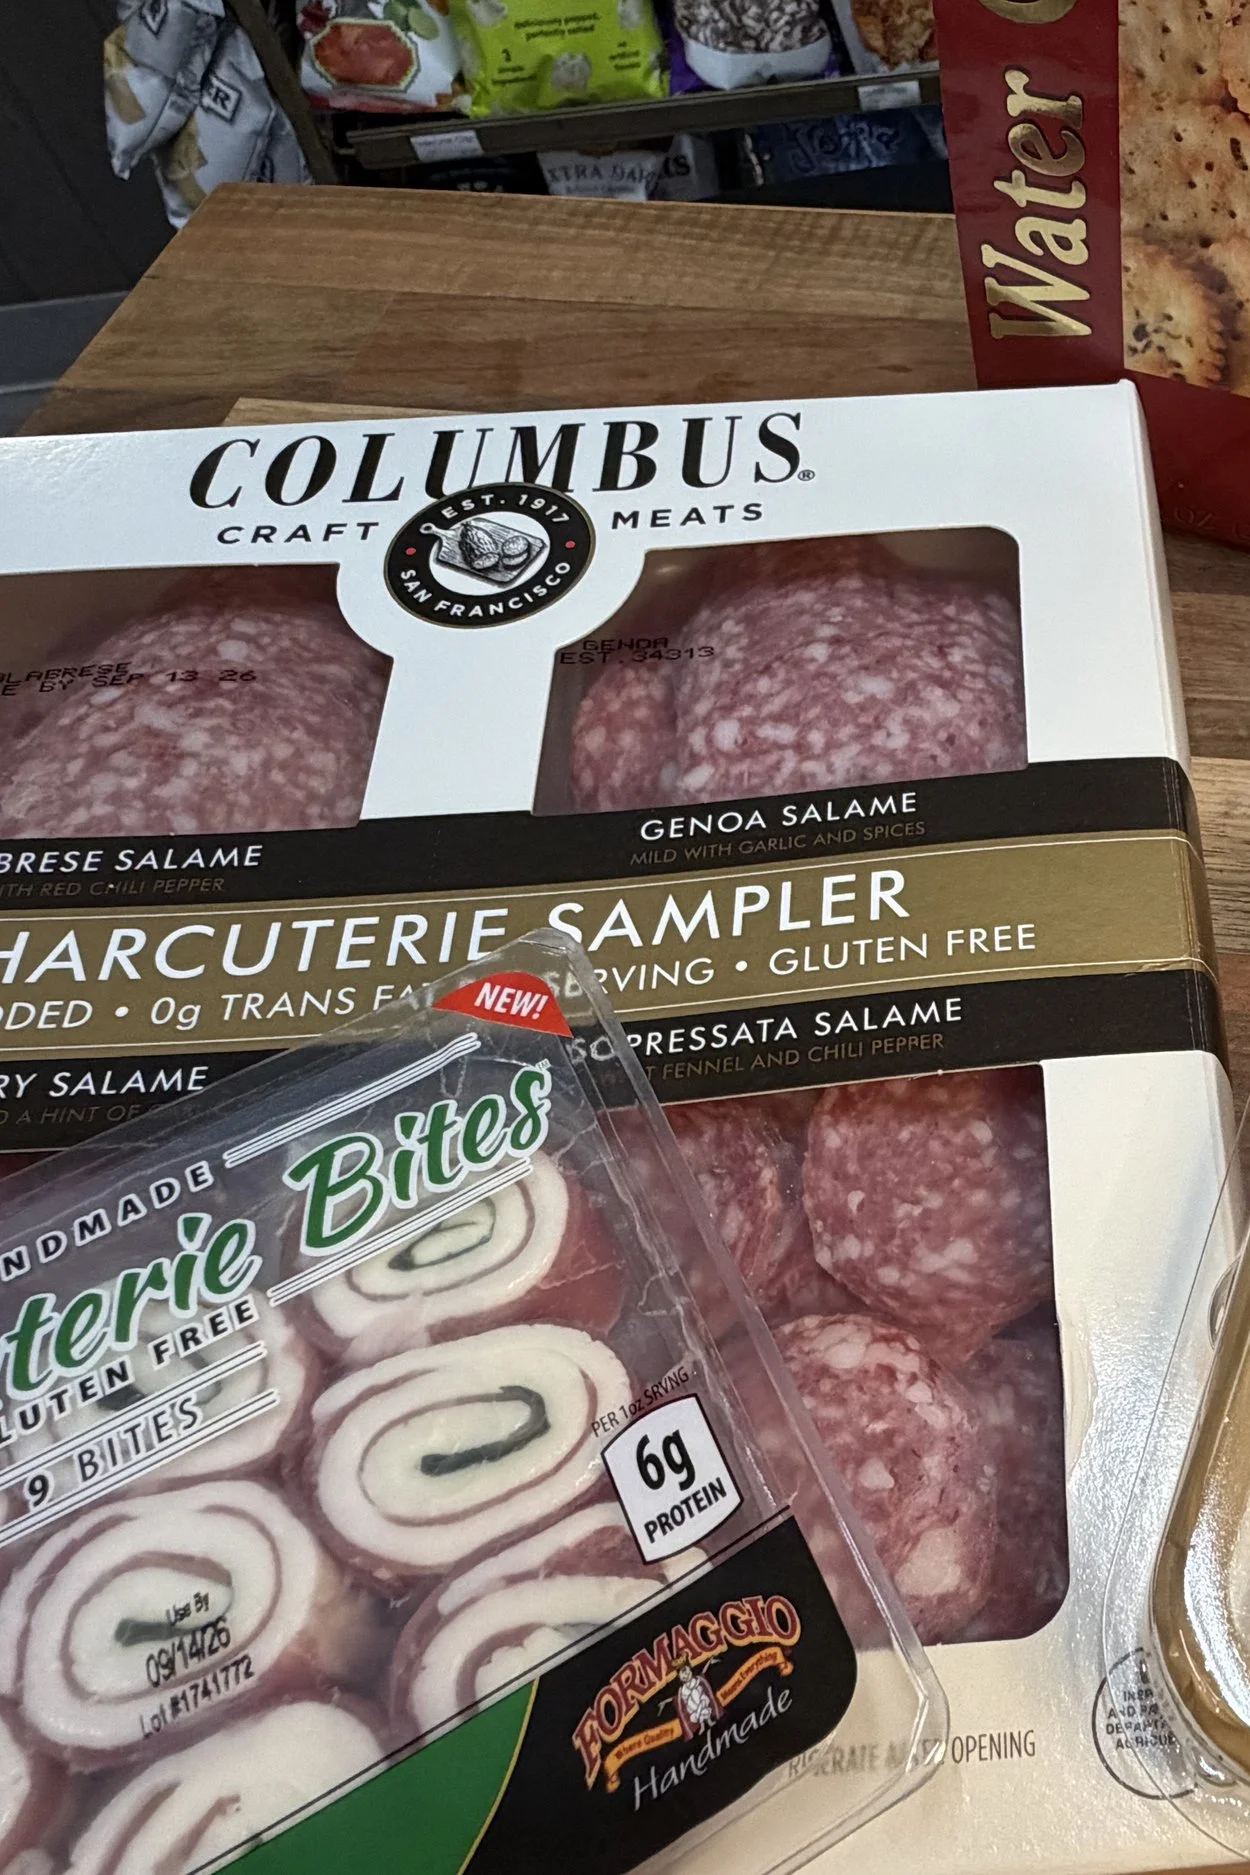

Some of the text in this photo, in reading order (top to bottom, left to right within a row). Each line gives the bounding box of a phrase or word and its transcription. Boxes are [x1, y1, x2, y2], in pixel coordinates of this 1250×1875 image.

[979, 68, 1092, 342] Water
[217, 503, 764, 545] CRAFT MEATS
[518, 494, 570, 524] 1917
[400, 562, 571, 618] SAN FRANCISCO
[39, 680, 73, 693] BY
[92, 673, 145, 688] SEP
[165, 670, 198, 683] 13
[219, 669, 257, 682] 26
[640, 792, 917, 841] GENOA SALAME
[114, 845, 262, 872] SALAME
[630, 821, 926, 866] MILD WITH GARLIC AND SPICES
[40, 882, 82, 896] RED
[90, 879, 144, 896] CHILI
[153, 878, 225, 893] PEPPER
[547, 869, 911, 952] SAMPLER
[769, 924, 1037, 977] GLUTEN FREE
[150, 996, 202, 1031] 0g
[221, 988, 356, 1022] TRANS
[474, 981, 549, 1020] NEW!
[814, 998, 963, 1037] SALAME
[662, 1056, 745, 1080] FENNEL
[751, 1048, 800, 1072] AND
[808, 1041, 864, 1064] CHILI
[871, 1032, 945, 1056] PEPPER
[49, 1066, 209, 1098] SALAME
[40, 1105, 101, 1124] HINT
[2, 1162, 212, 1280] NDMADE
[150, 1296, 259, 1369] FREE
[591, 1365, 689, 1438] PER 1oz SRVNG
[27, 1394, 202, 1507] 9 BITES
[635, 1425, 697, 1491] 6g
[643, 1477, 728, 1545] PROTEIN
[165, 1591, 210, 1627] Use By
[145, 1614, 232, 1688] 09/14/26
[571, 1594, 802, 1791] FORMAGGIO
[139, 1703, 169, 1739] Lot
[632, 1685, 793, 1812] Handmade
[951, 1729, 1036, 1764] OPENING
